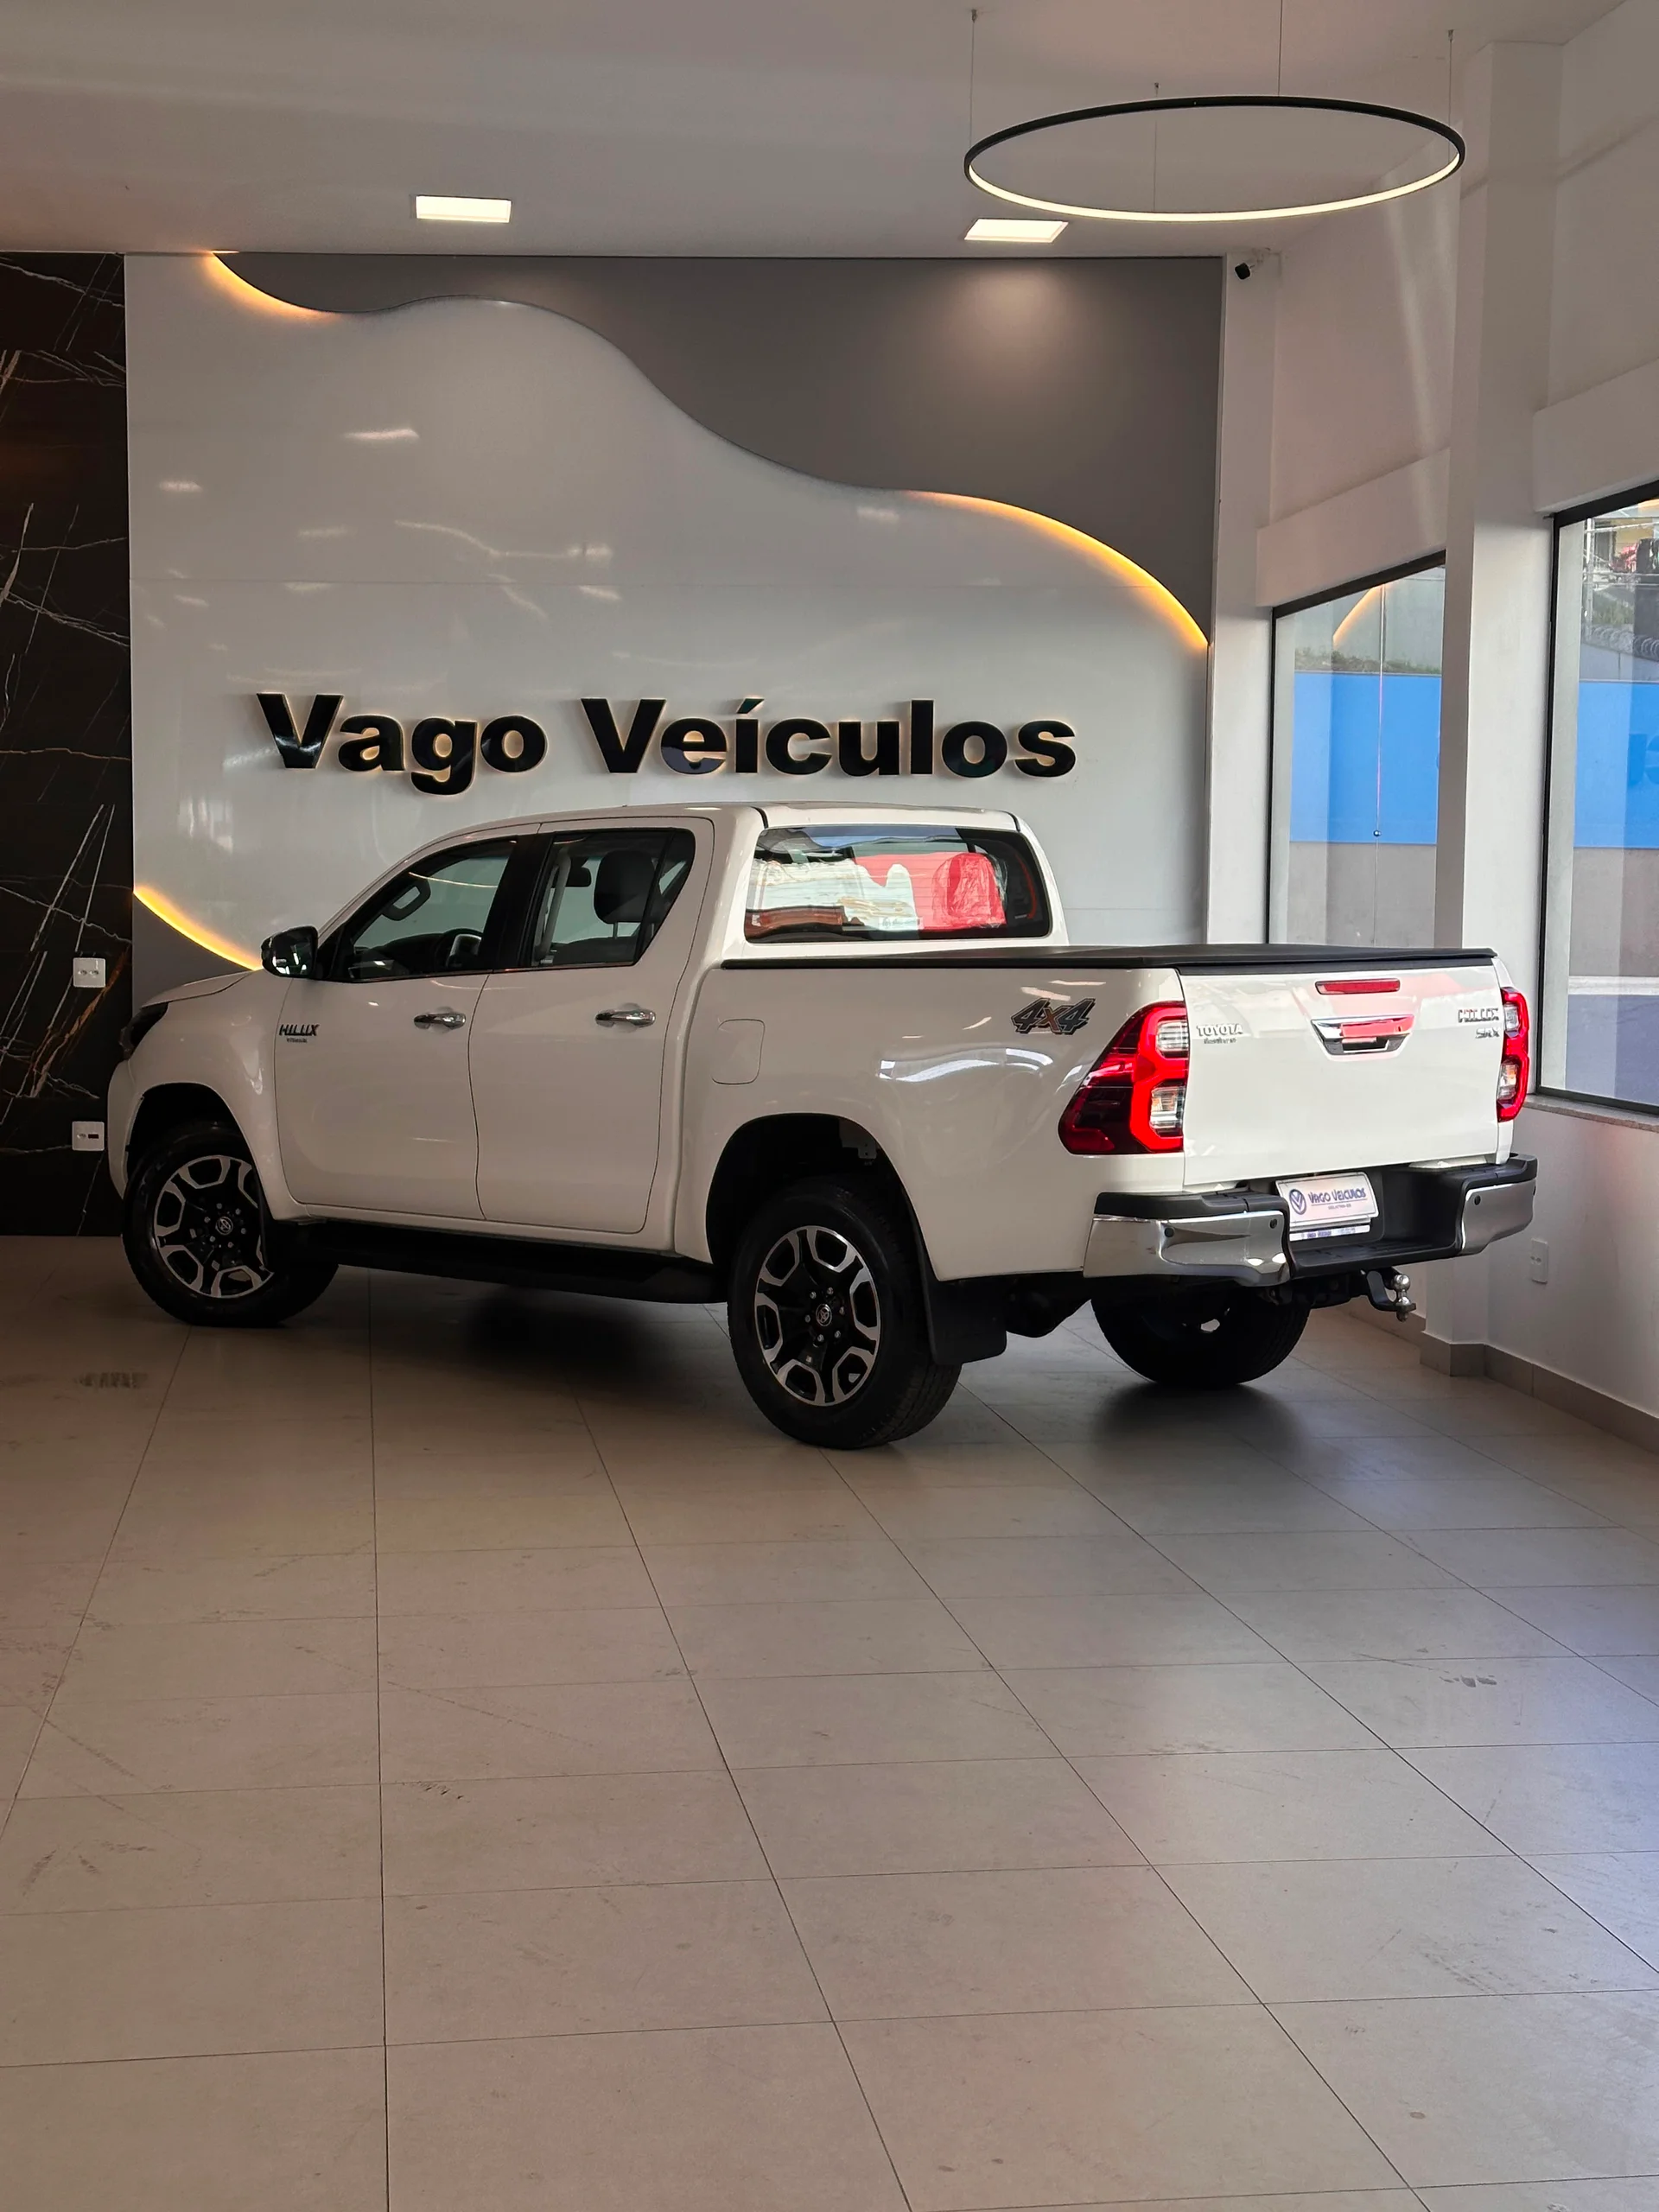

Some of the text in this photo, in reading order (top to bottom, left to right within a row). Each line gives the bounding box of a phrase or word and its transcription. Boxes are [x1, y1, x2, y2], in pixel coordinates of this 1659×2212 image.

[256, 693, 1077, 796] Vago Veículos
[278, 1024, 320, 1036] HILUX
[1196, 1023, 1243, 1037] TOYOTA
[1307, 1191, 1332, 1204] VAGO
